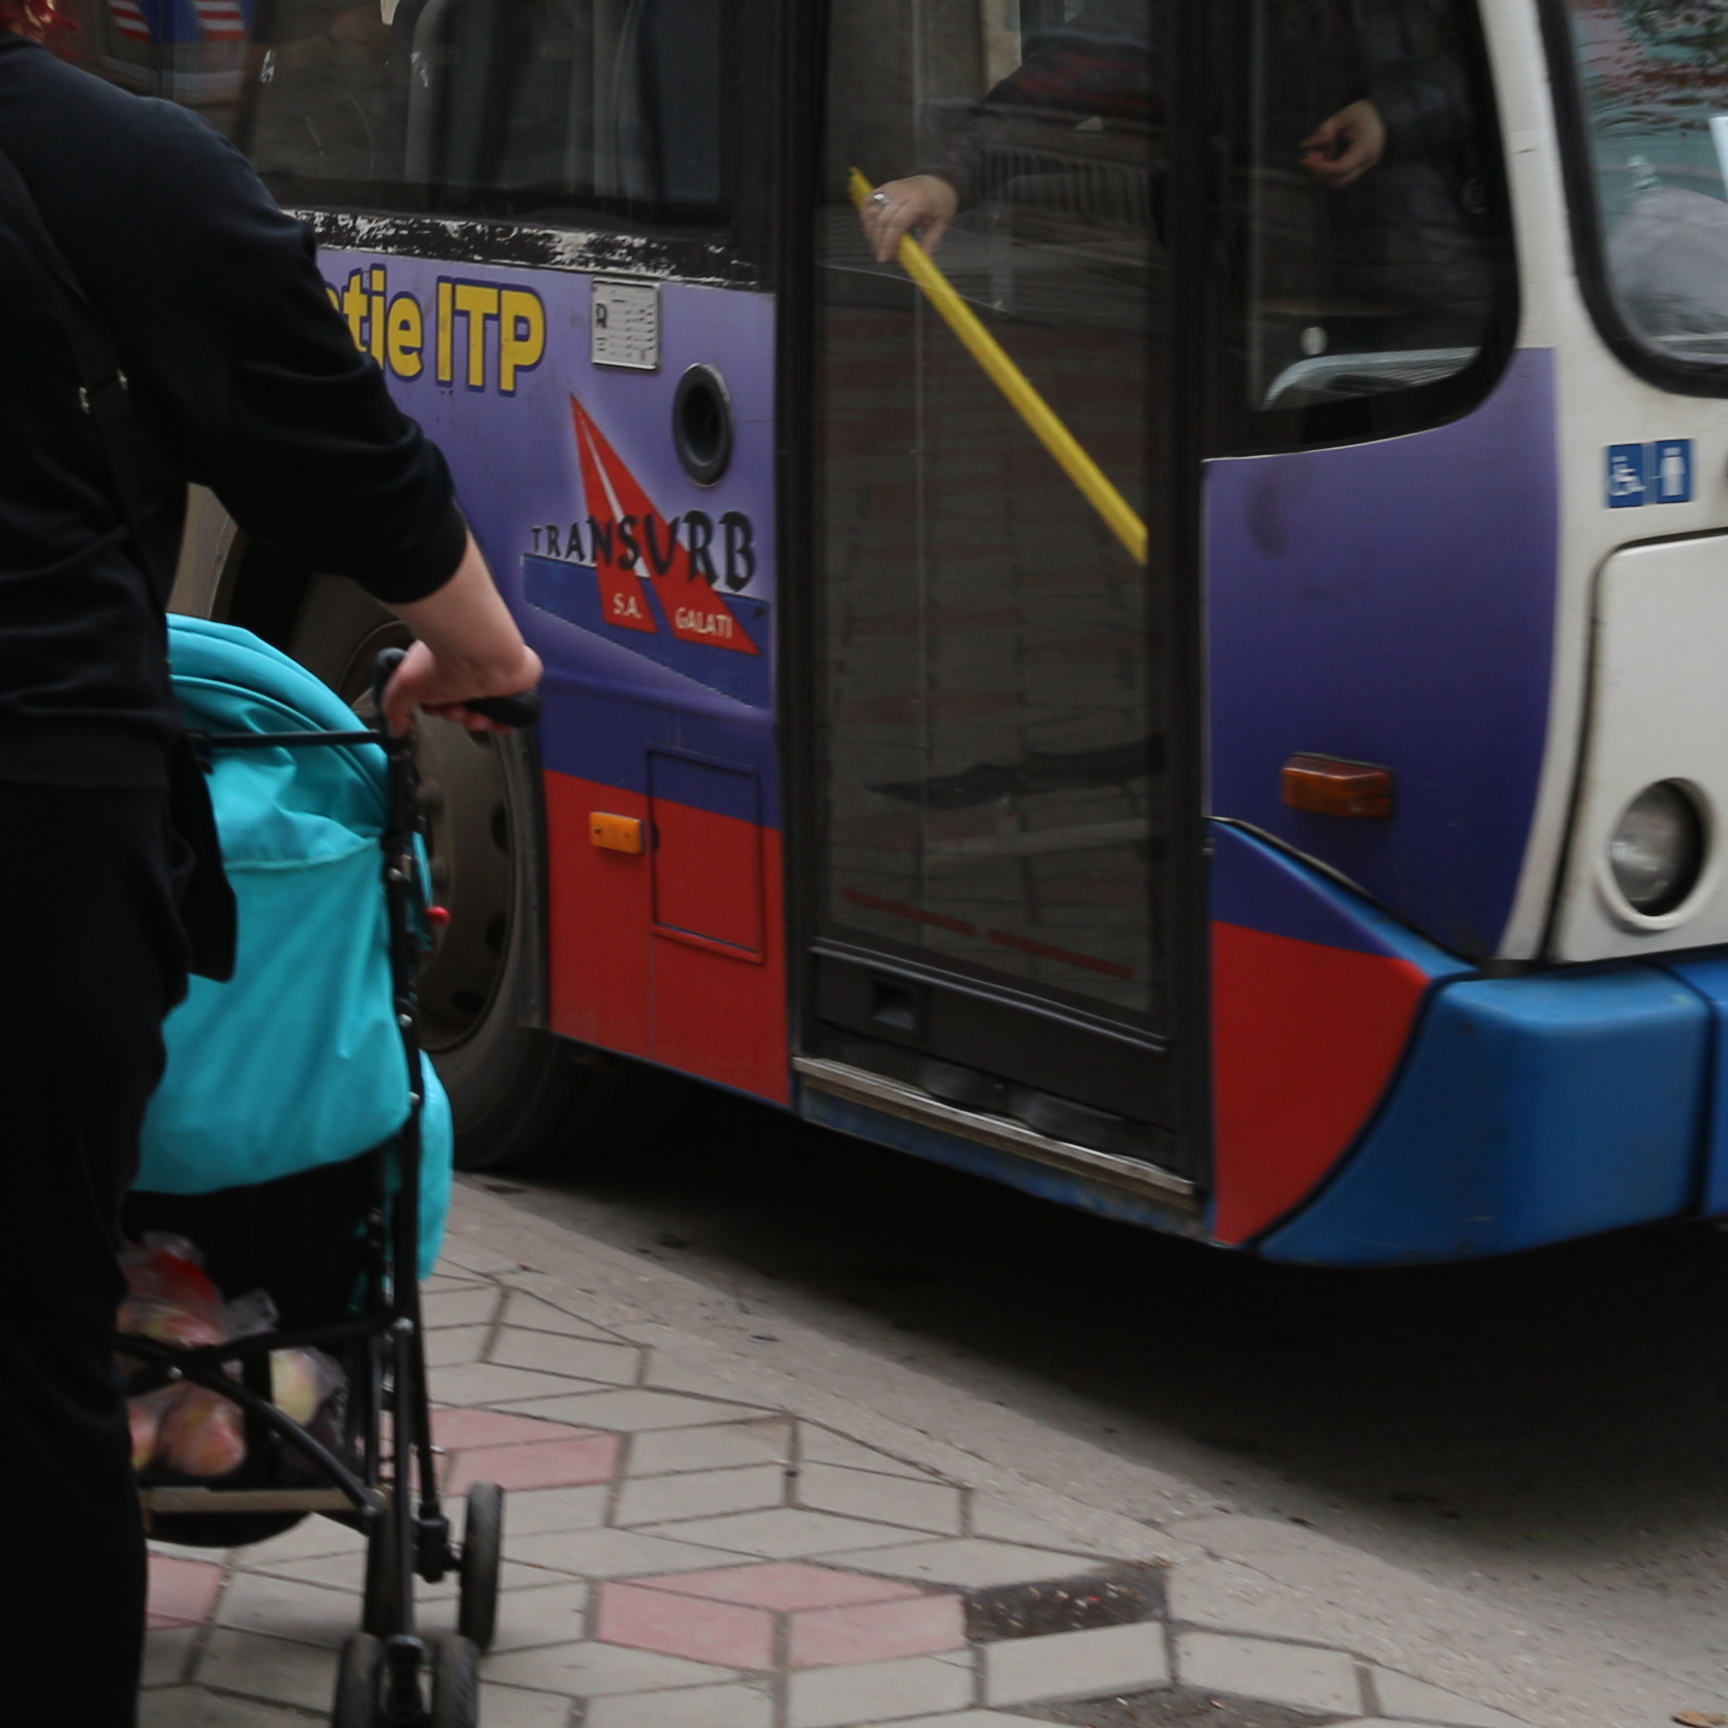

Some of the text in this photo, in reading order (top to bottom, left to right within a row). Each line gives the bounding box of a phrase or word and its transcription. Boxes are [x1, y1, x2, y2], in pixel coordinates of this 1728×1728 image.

[326, 265, 423, 380] tie
[436, 280, 546, 394] ITP
[529, 508, 756, 592] TRANSURB
[613, 592, 643, 619] S.A.
[674, 607, 733, 639] GALATI
